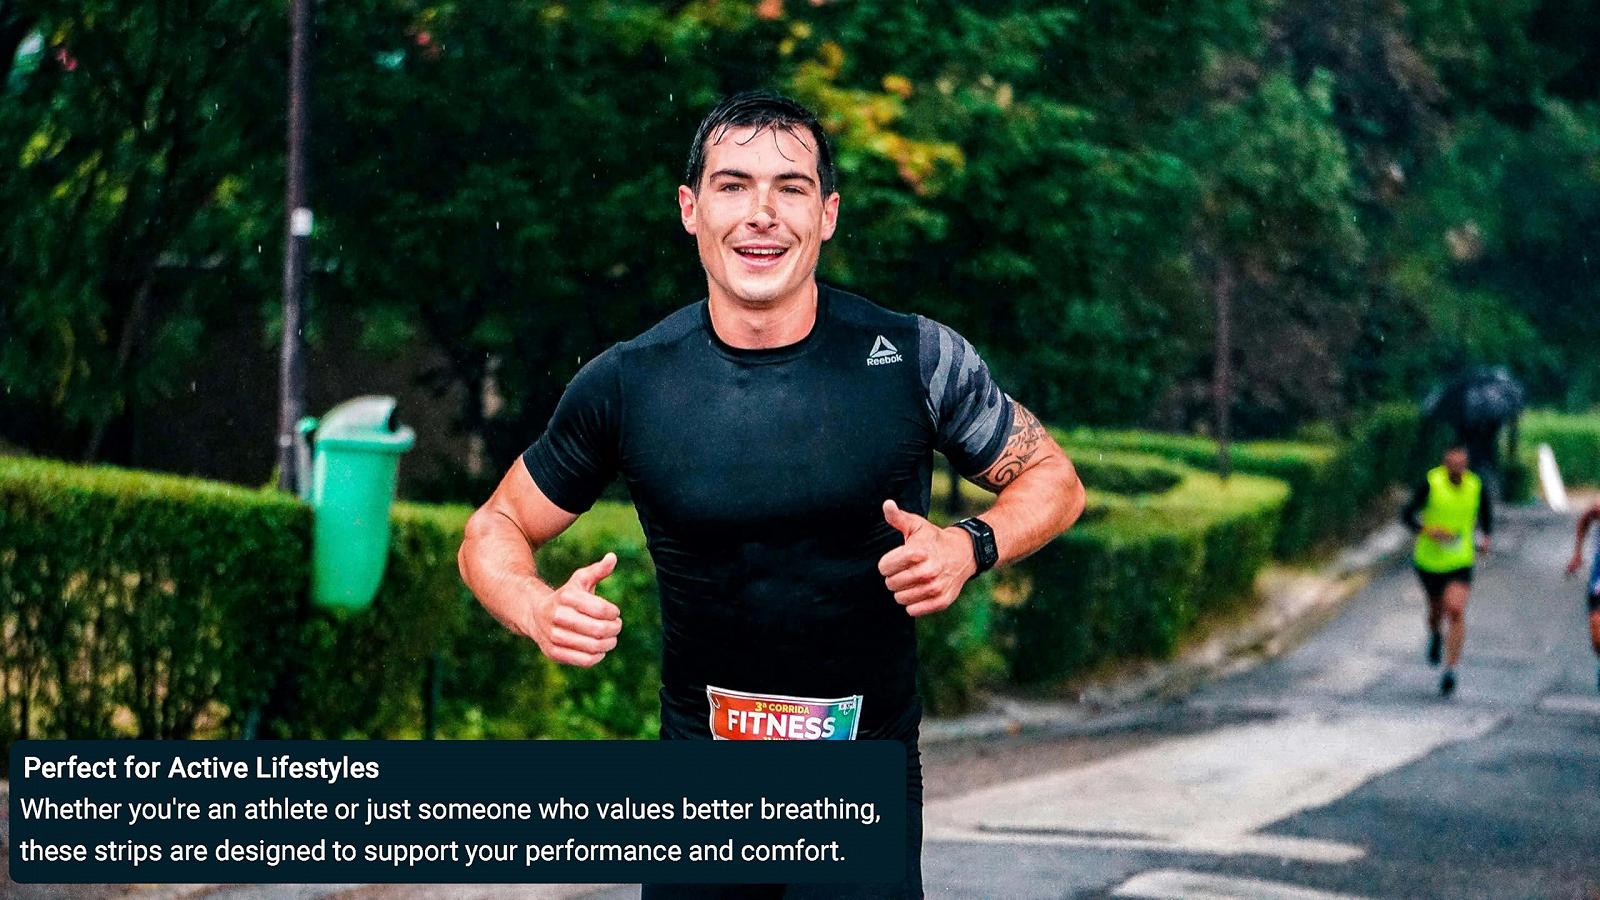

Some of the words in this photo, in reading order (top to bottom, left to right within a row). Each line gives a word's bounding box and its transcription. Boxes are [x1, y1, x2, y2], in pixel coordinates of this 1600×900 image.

[866, 354, 903, 366] Reebok
[768, 703, 810, 715] CORRIDA
[727, 709, 836, 740] FITNESS
